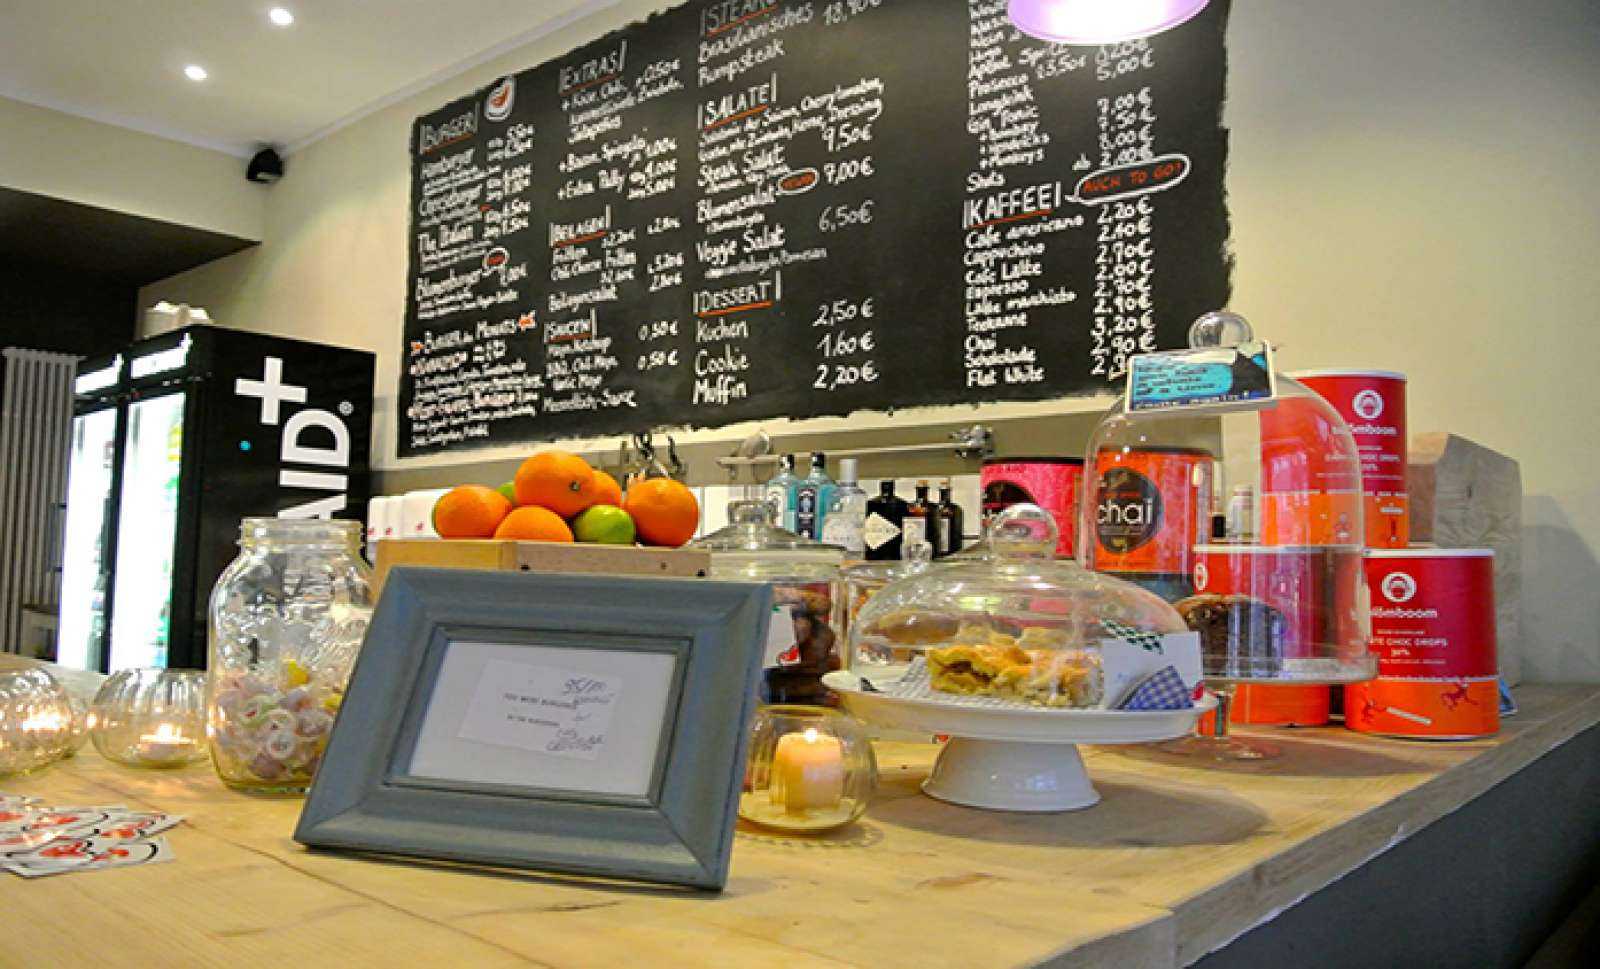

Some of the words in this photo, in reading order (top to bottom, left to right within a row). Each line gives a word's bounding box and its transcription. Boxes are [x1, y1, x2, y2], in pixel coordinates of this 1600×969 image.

[704, 83, 770, 125] SALATE
[970, 184, 1054, 226] KAFFEE
[699, 280, 772, 314] DESSERT
[694, 343, 751, 378] Cookie
[692, 374, 748, 406] Muffin
[1097, 497, 1153, 525] chai
